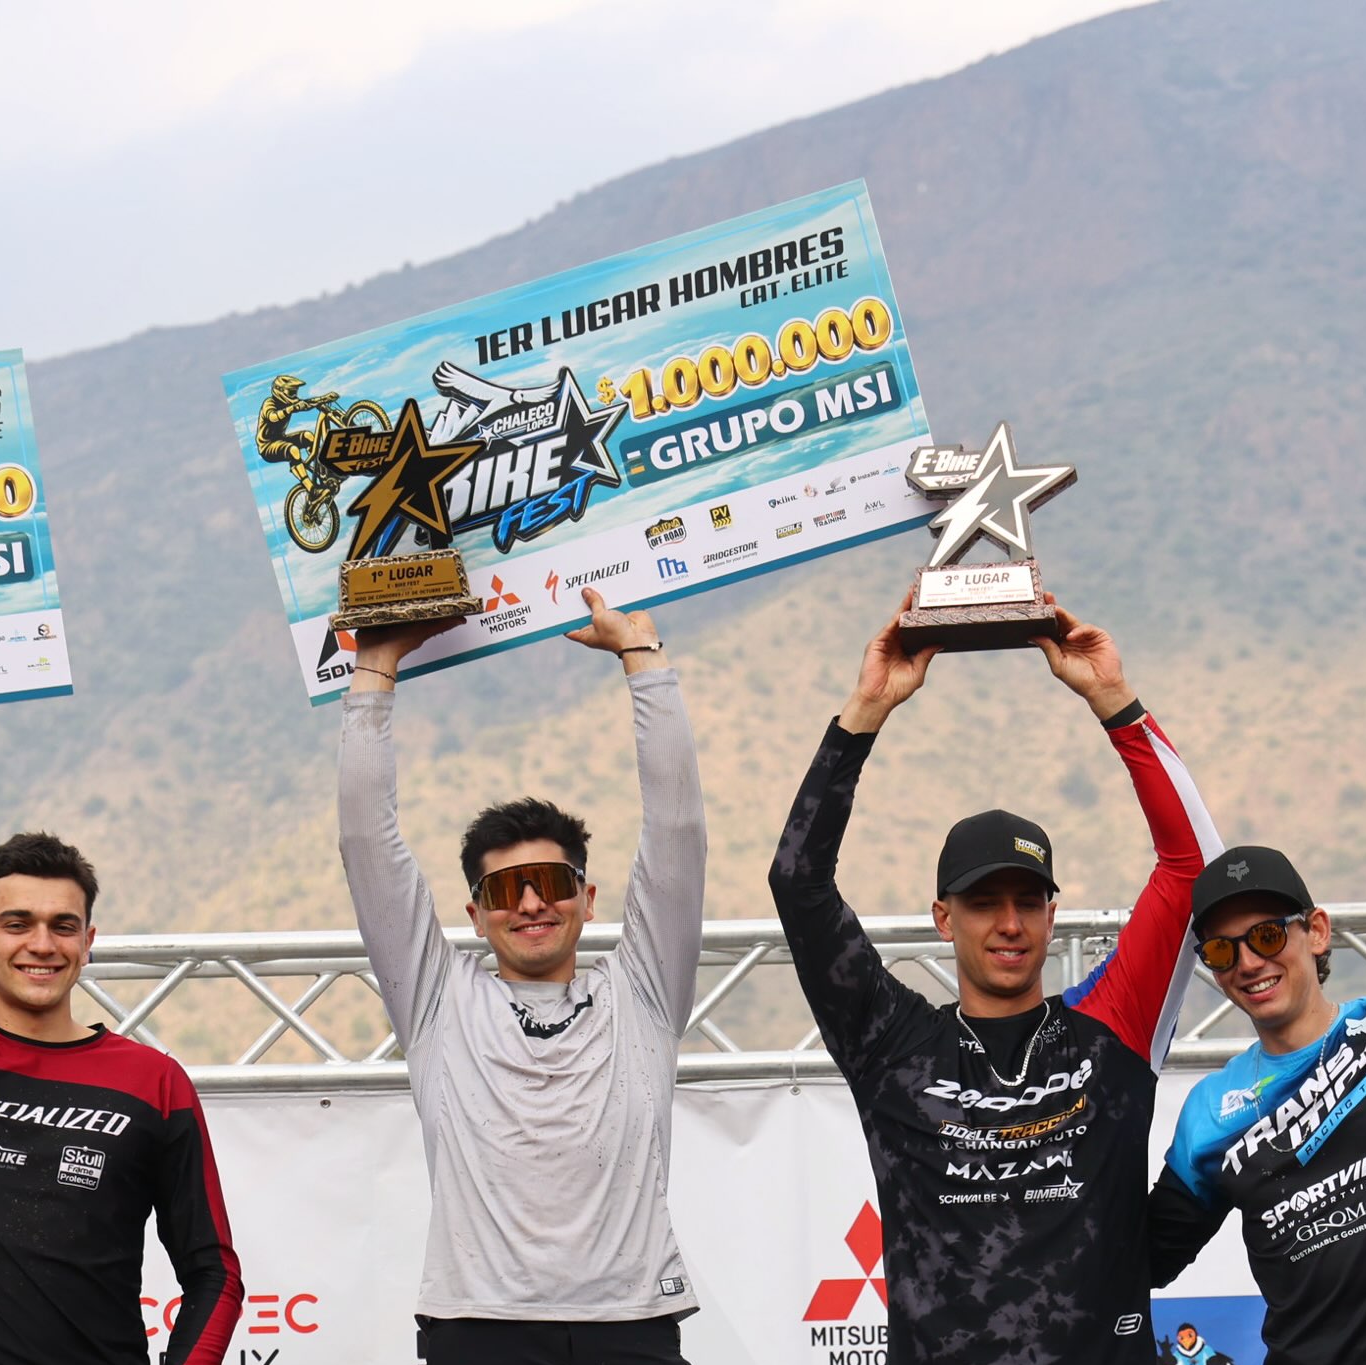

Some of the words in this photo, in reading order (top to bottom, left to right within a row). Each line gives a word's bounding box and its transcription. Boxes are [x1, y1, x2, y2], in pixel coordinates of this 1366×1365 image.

[474, 323, 534, 366] 1ER
[541, 282, 661, 347] LUGAR
[670, 226, 844, 307] HOMBRES
[493, 401, 555, 433] CHALECO
[649, 398, 805, 471] GRUPO
[817, 369, 893, 419] MSI
[498, 470, 596, 549] FEST
[815, 515, 847, 528] TRAINING
[650, 536, 663, 548] OFF
[665, 528, 684, 543] ROAD
[703, 541, 759, 564] BRIDGESTONE
[389, 564, 433, 580] LUGAR
[565, 561, 630, 591] SPECIALIZED
[965, 572, 1010, 586] LUGAR
[480, 605, 531, 628] MITSUBISHI
[489, 617, 528, 635] MOTORS
[317, 661, 356, 684] SDL
[1305, 1100, 1353, 1156] RACING
[955, 1140, 1041, 1150] CHANGAN
[64, 1149, 103, 1168] Skull
[67, 1164, 94, 1175] Frame
[60, 1173, 97, 1187] Protector
[939, 1193, 998, 1205] SCHWALBE
[139, 1293, 319, 1337] COEC
[810, 1326, 888, 1346] MITSUB
